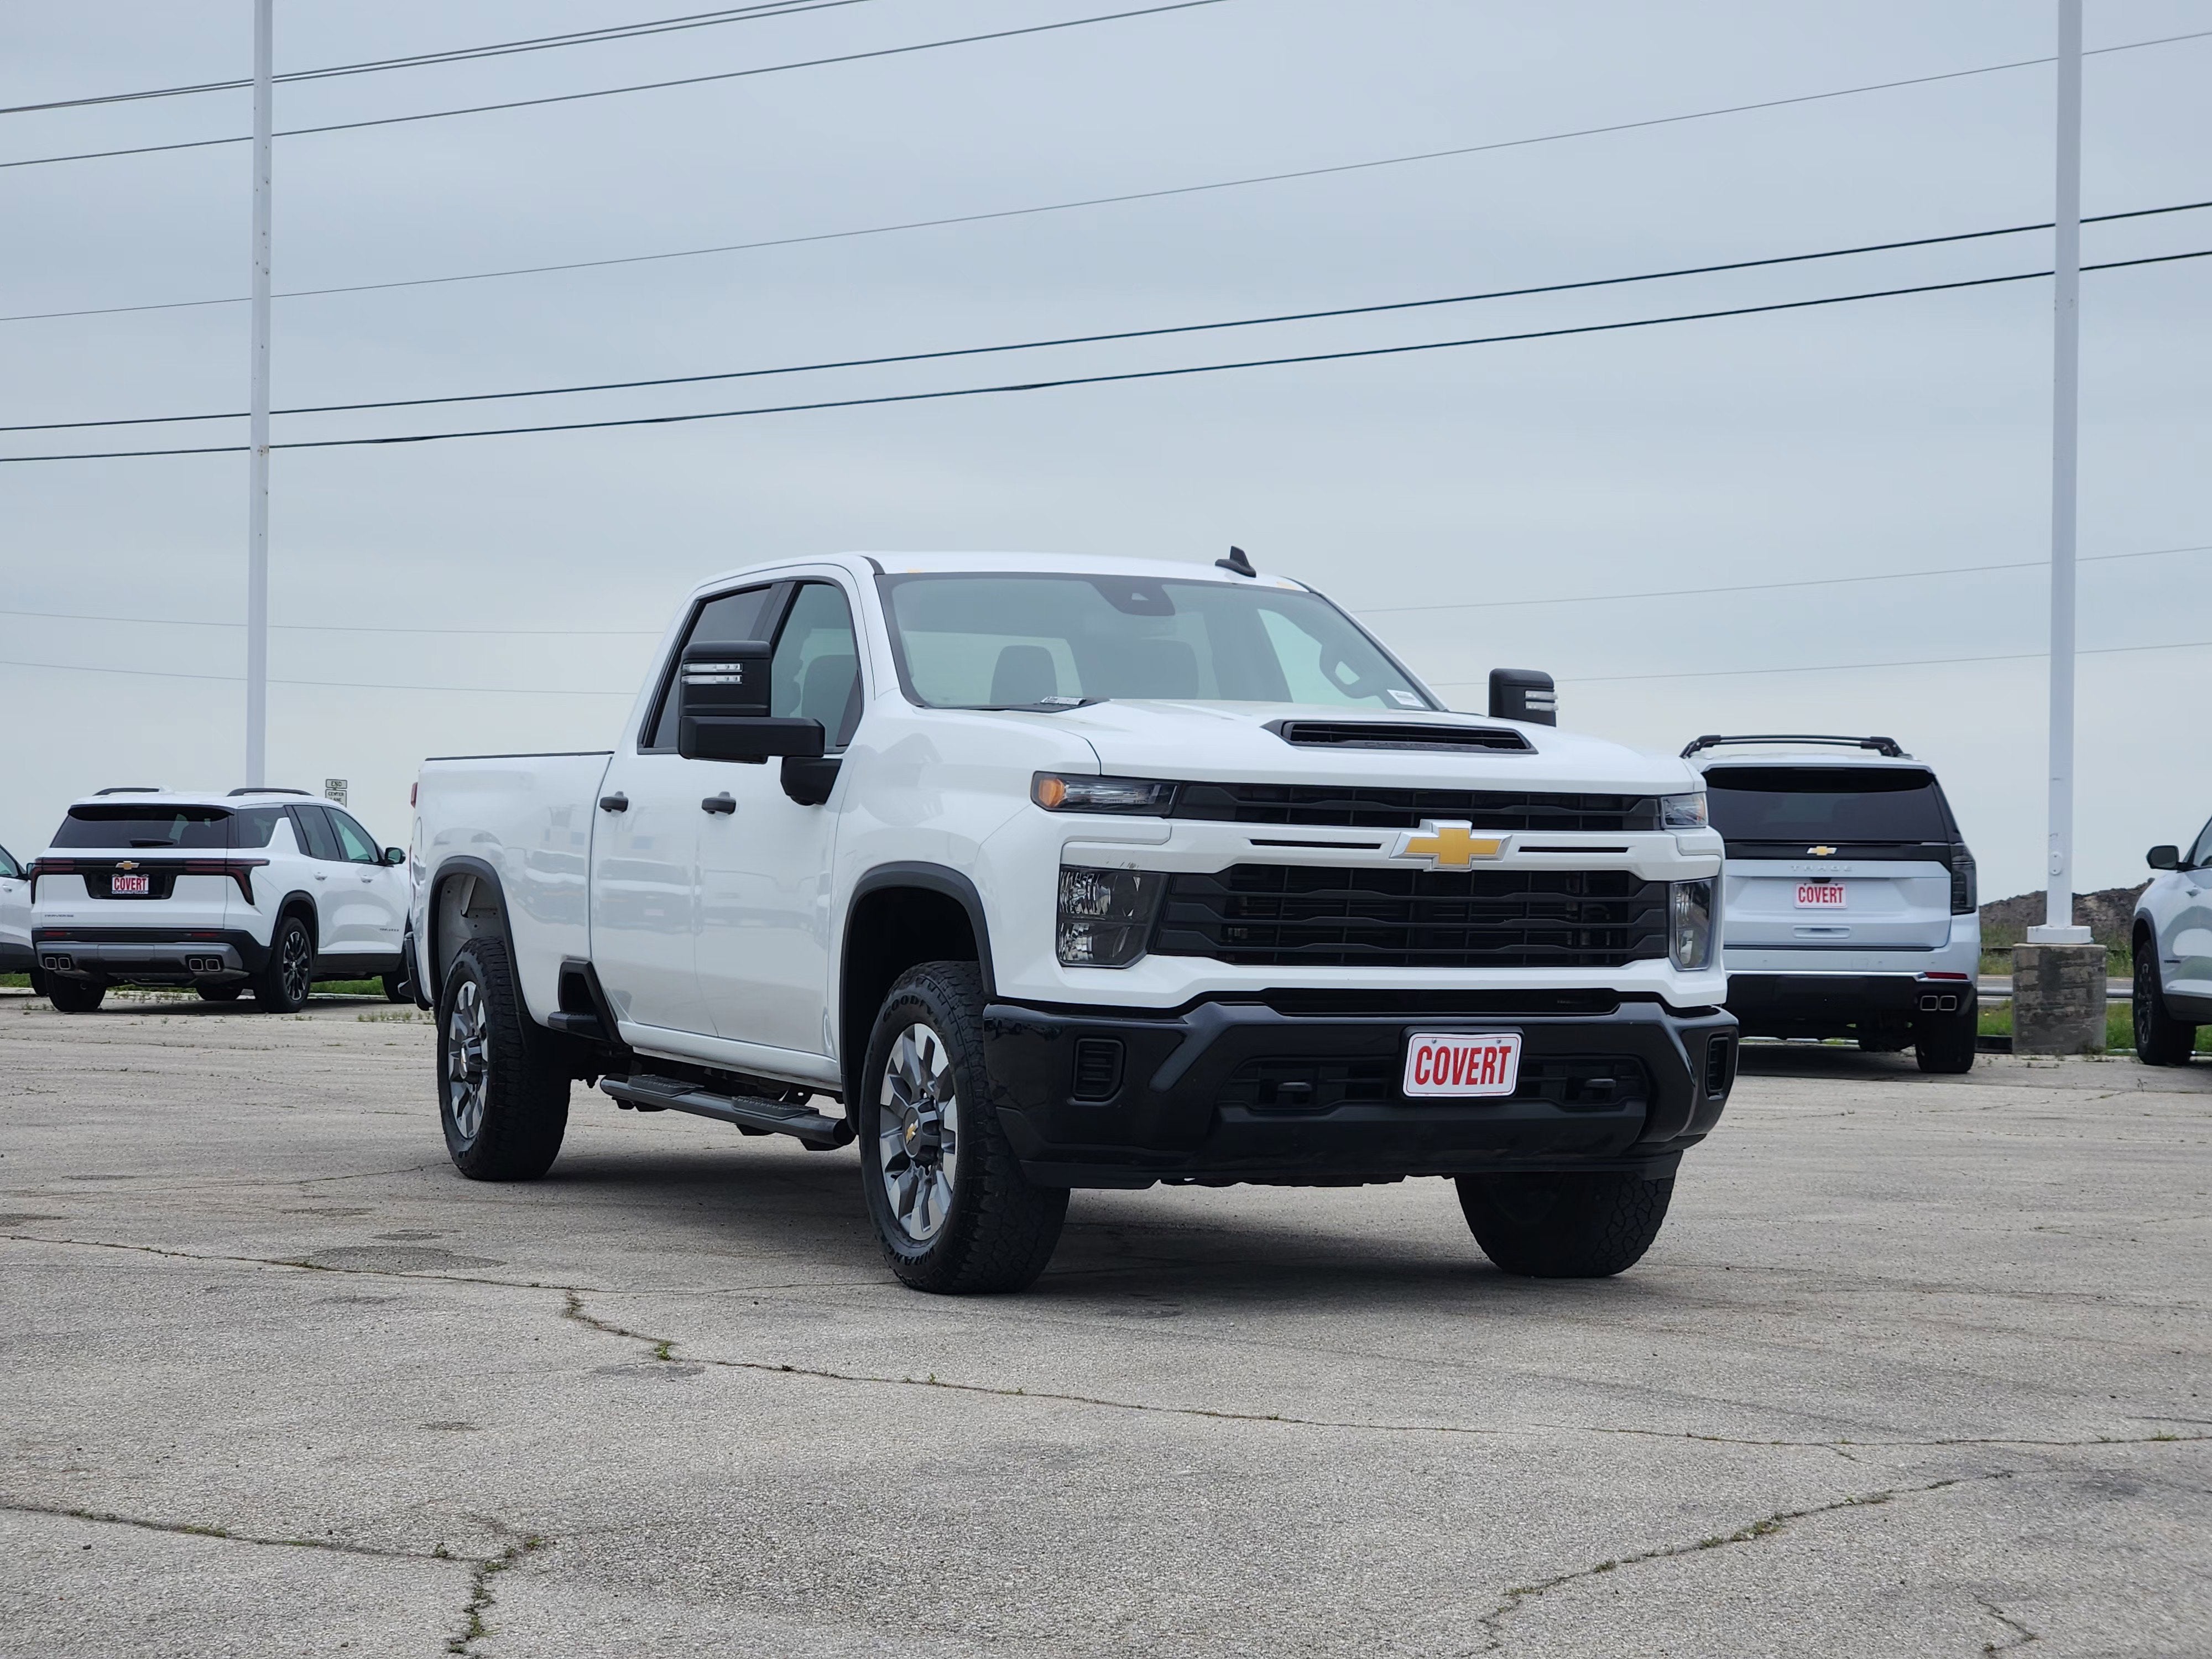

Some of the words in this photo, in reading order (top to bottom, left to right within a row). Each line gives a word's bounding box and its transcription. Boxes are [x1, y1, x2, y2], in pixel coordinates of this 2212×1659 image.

[1364, 742, 1472, 751] CHEVROLET
[114, 877, 147, 890] COVERT
[1798, 886, 1844, 902] COVERT
[1415, 1045, 1512, 1086] COVERT
